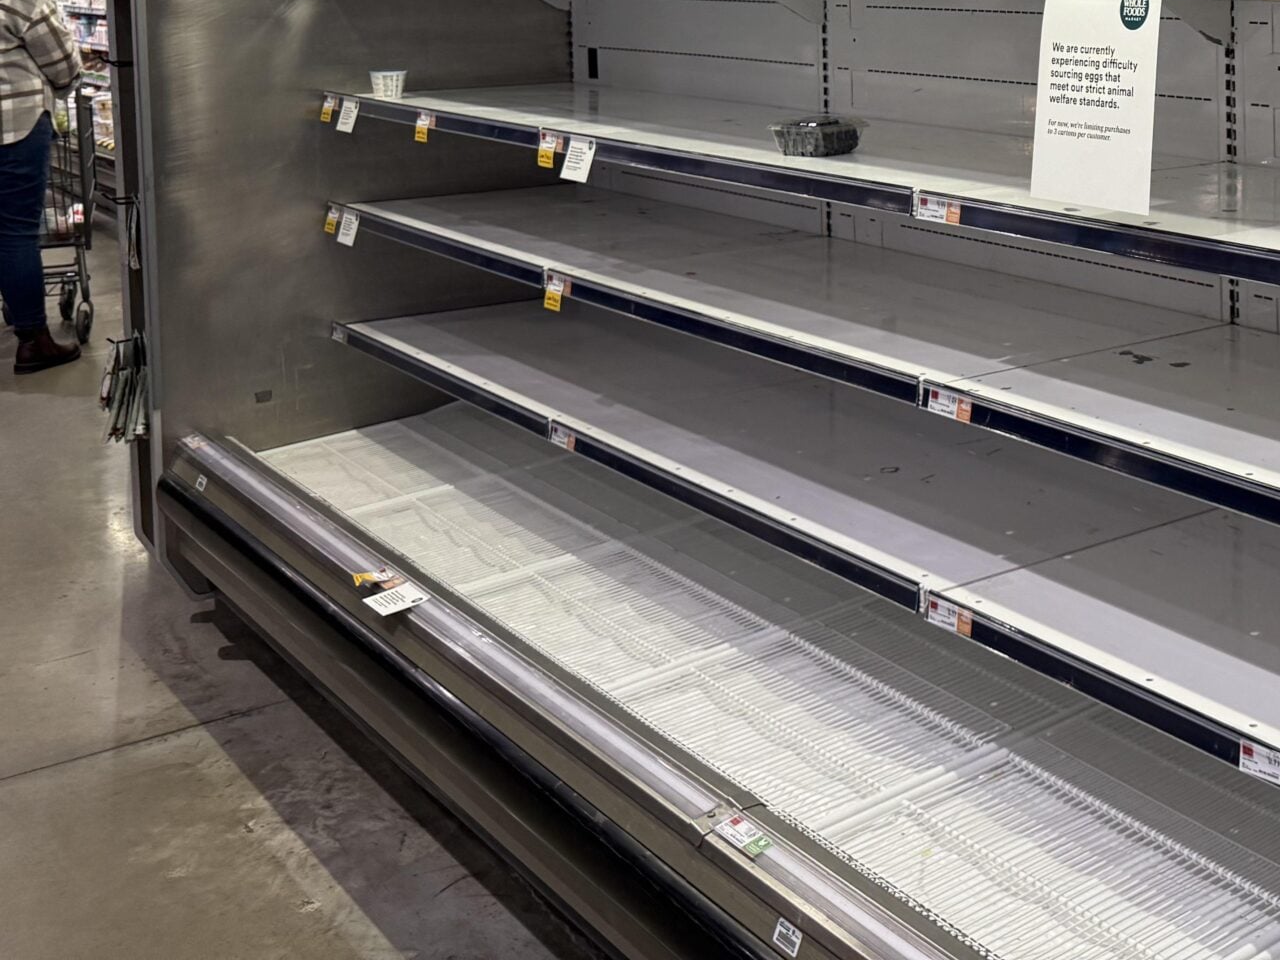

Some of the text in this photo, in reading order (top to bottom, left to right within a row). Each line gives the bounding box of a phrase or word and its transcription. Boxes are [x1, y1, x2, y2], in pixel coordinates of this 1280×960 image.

[1123, 7, 1146, 17] FOODS
[1052, 42, 1115, 57] We are currently
[1051, 56, 1138, 72] experiencing difficulty
[1050, 69, 1120, 83] sourcing eggs that
[1049, 82, 1134, 97] meet our strict animal
[1049, 94, 1120, 109] welfare standards.
[1058, 129, 1077, 137] cartons
[1077, 131, 1086, 139] per
[1087, 133, 1111, 141] customer.
[1084, 121, 1104, 133] limiting
[1104, 125, 1131, 135] purchases
